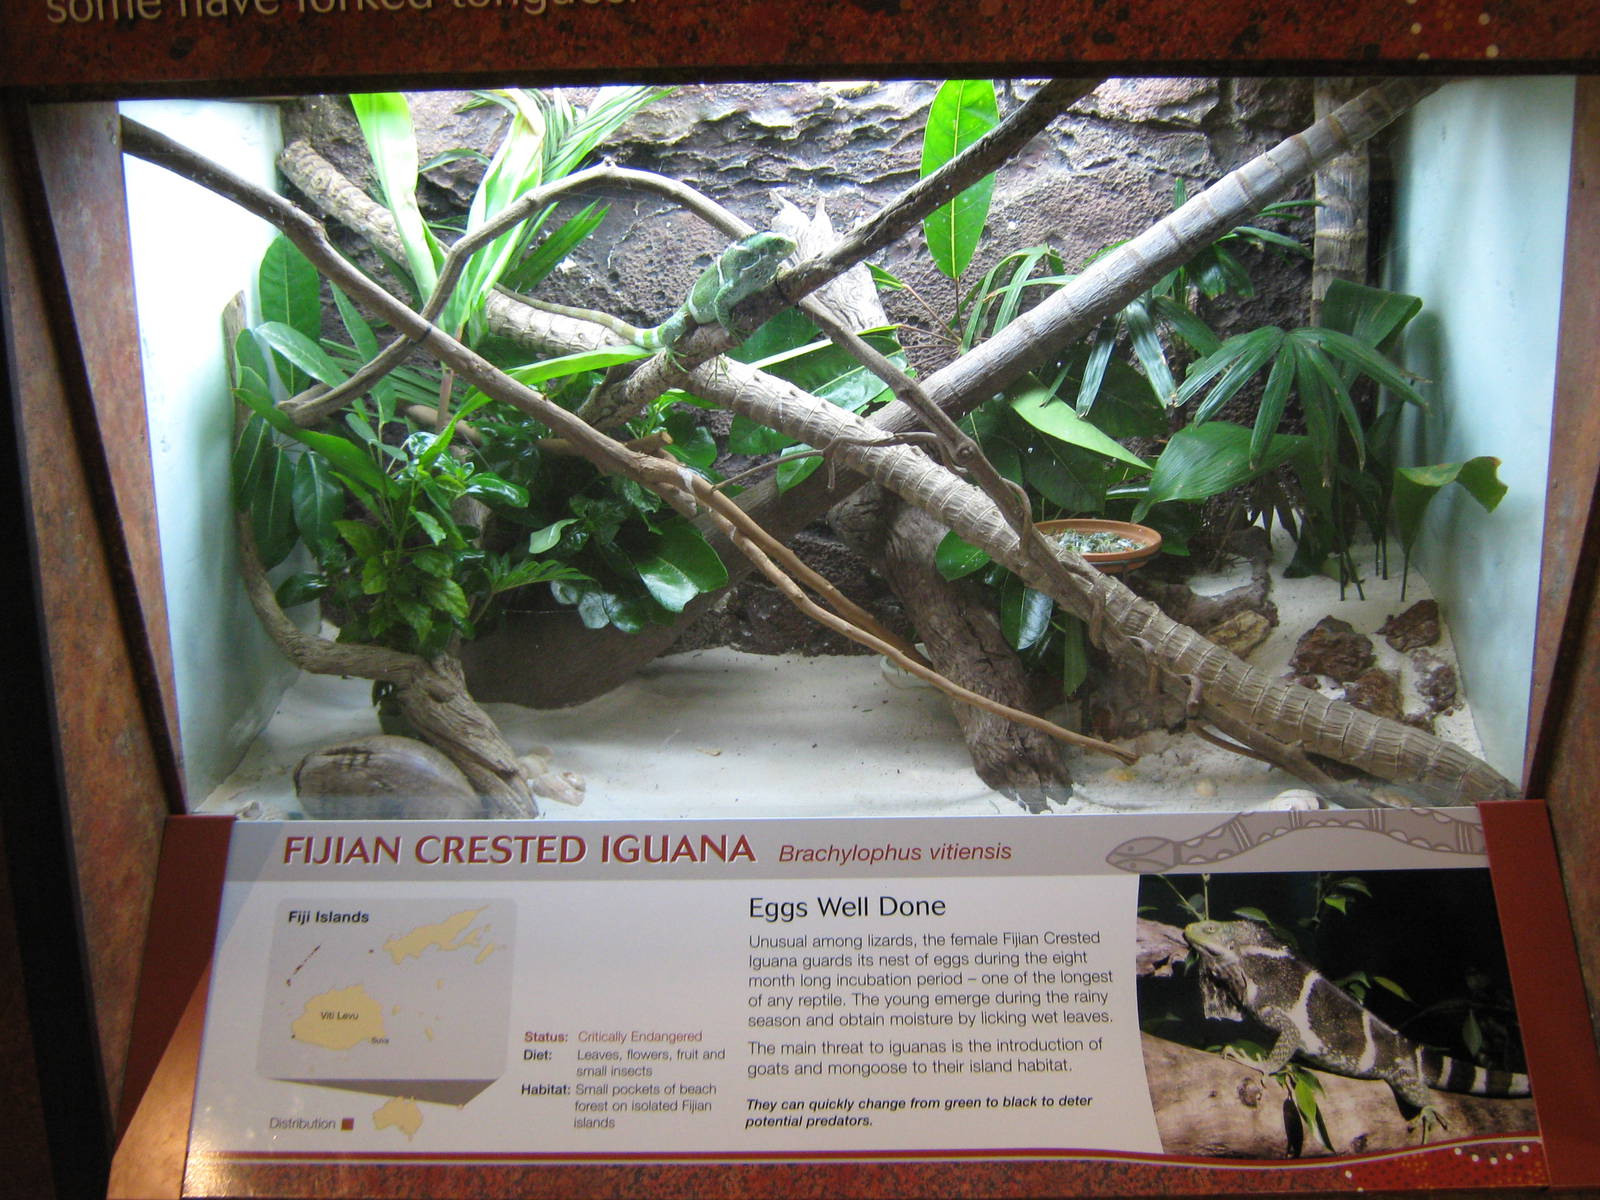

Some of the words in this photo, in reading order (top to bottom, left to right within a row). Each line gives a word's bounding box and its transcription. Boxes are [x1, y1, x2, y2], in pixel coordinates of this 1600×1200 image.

[47, 0, 162, 23] some
[284, 837, 400, 864] FIJIAN
[415, 835, 586, 864] CRESTED
[602, 834, 756, 864] IGUANA
[779, 845, 921, 865] Brachylophus
[930, 843, 1011, 860] vitiensis
[750, 898, 807, 922] Eggs
[818, 897, 868, 917] Well
[880, 897, 945, 916] Done
[289, 911, 310, 925] Fiji
[316, 911, 368, 922] Islands
[750, 935, 807, 948] Unusual
[813, 937, 862, 950] among
[868, 934, 916, 948] lizards,
[923, 934, 945, 946] the
[951, 933, 997, 945] female
[1004, 932, 1038, 947] Fijian
[1044, 931, 1100, 944] Crested
[750, 955, 797, 969] Iguana
[803, 954, 852, 970] guards
[858, 954, 873, 966] its
[879, 954, 909, 966] nest
[915, 953, 928, 966] of
[934, 955, 969, 968] eggs
[975, 952, 1019, 967] during
[1025, 952, 1047, 964] the
[1053, 951, 1087, 966] eight
[749, 974, 794, 987] month
[801, 974, 831, 990] long
[837, 973, 911, 986] incubation
[917, 972, 962, 989] period
[982, 975, 1008, 984] one
[1014, 971, 1027, 984] of
[1033, 971, 1055, 983] the
[1061, 970, 1112, 985] longest
[748, 994, 762, 1007] of
[768, 997, 793, 1009] any
[799, 993, 845, 1009] reptile.
[852, 993, 879, 1006] The
[885, 995, 929, 1008] young
[935, 994, 990, 1007] emerge
[996, 991, 1040, 1006] during
[1047, 990, 1069, 1003] the
[1075, 990, 1108, 1005] rainy
[337, 1012, 359, 1020] Levu
[749, 1017, 800, 1027] season
[807, 1013, 833, 1026] and
[840, 1013, 884, 1026] obtain
[891, 1013, 953, 1025] moisture
[959, 1011, 976, 1027] by
[982, 1011, 1026, 1026] licking
[1032, 1011, 1057, 1023] wet
[1064, 1010, 1112, 1023] leaves.
[525, 1032, 568, 1042] Status:
[578, 1031, 627, 1044] Critically
[631, 1031, 702, 1044] Endangered
[748, 1041, 775, 1054] The
[781, 1041, 816, 1054] main
[822, 1041, 863, 1054] threat
[870, 1041, 883, 1053] to
[890, 1040, 946, 1056] iguanas
[952, 1040, 963, 1052] is
[969, 1040, 991, 1052] the
[997, 1038, 1083, 1052] introduction
[1089, 1037, 1102, 1050] of
[524, 1050, 551, 1060] Diet:
[578, 1050, 622, 1061] Leaves,
[628, 1049, 671, 1061] flowers,
[677, 1049, 698, 1059] fruit
[703, 1049, 725, 1060] and
[577, 1066, 607, 1076] small
[611, 1066, 652, 1076] insects
[748, 1063, 789, 1077] goats
[795, 1062, 822, 1074] and
[828, 1063, 907, 1077] mongoose
[913, 1061, 927, 1073] to
[933, 1060, 964, 1073] their
[970, 1059, 1012, 1072] island
[1018, 1059, 1072, 1071] habitat.
[522, 1084, 570, 1095] Habitat:
[576, 1084, 608, 1095] Small
[612, 1084, 660, 1096] pockets
[664, 1084, 675, 1094] of
[680, 1084, 716, 1094] beach
[575, 1101, 608, 1111] forest
[612, 1103, 627, 1111] on
[632, 1100, 677, 1111] isolated
[682, 1100, 711, 1114] Fijian
[747, 1099, 777, 1112] They
[782, 1101, 804, 1110] can
[809, 1099, 854, 1112] quickly
[859, 1098, 905, 1111] change
[911, 1098, 940, 1108] from
[945, 1099, 981, 1110] green
[987, 1097, 998, 1107] to
[1003, 1096, 1037, 1107] black
[1042, 1096, 1054, 1106] to
[1059, 1096, 1092, 1106] deter
[269, 1117, 336, 1129] Distribution
[574, 1117, 615, 1128] islands
[745, 1116, 802, 1129] potential
[806, 1116, 872, 1128] predators.
